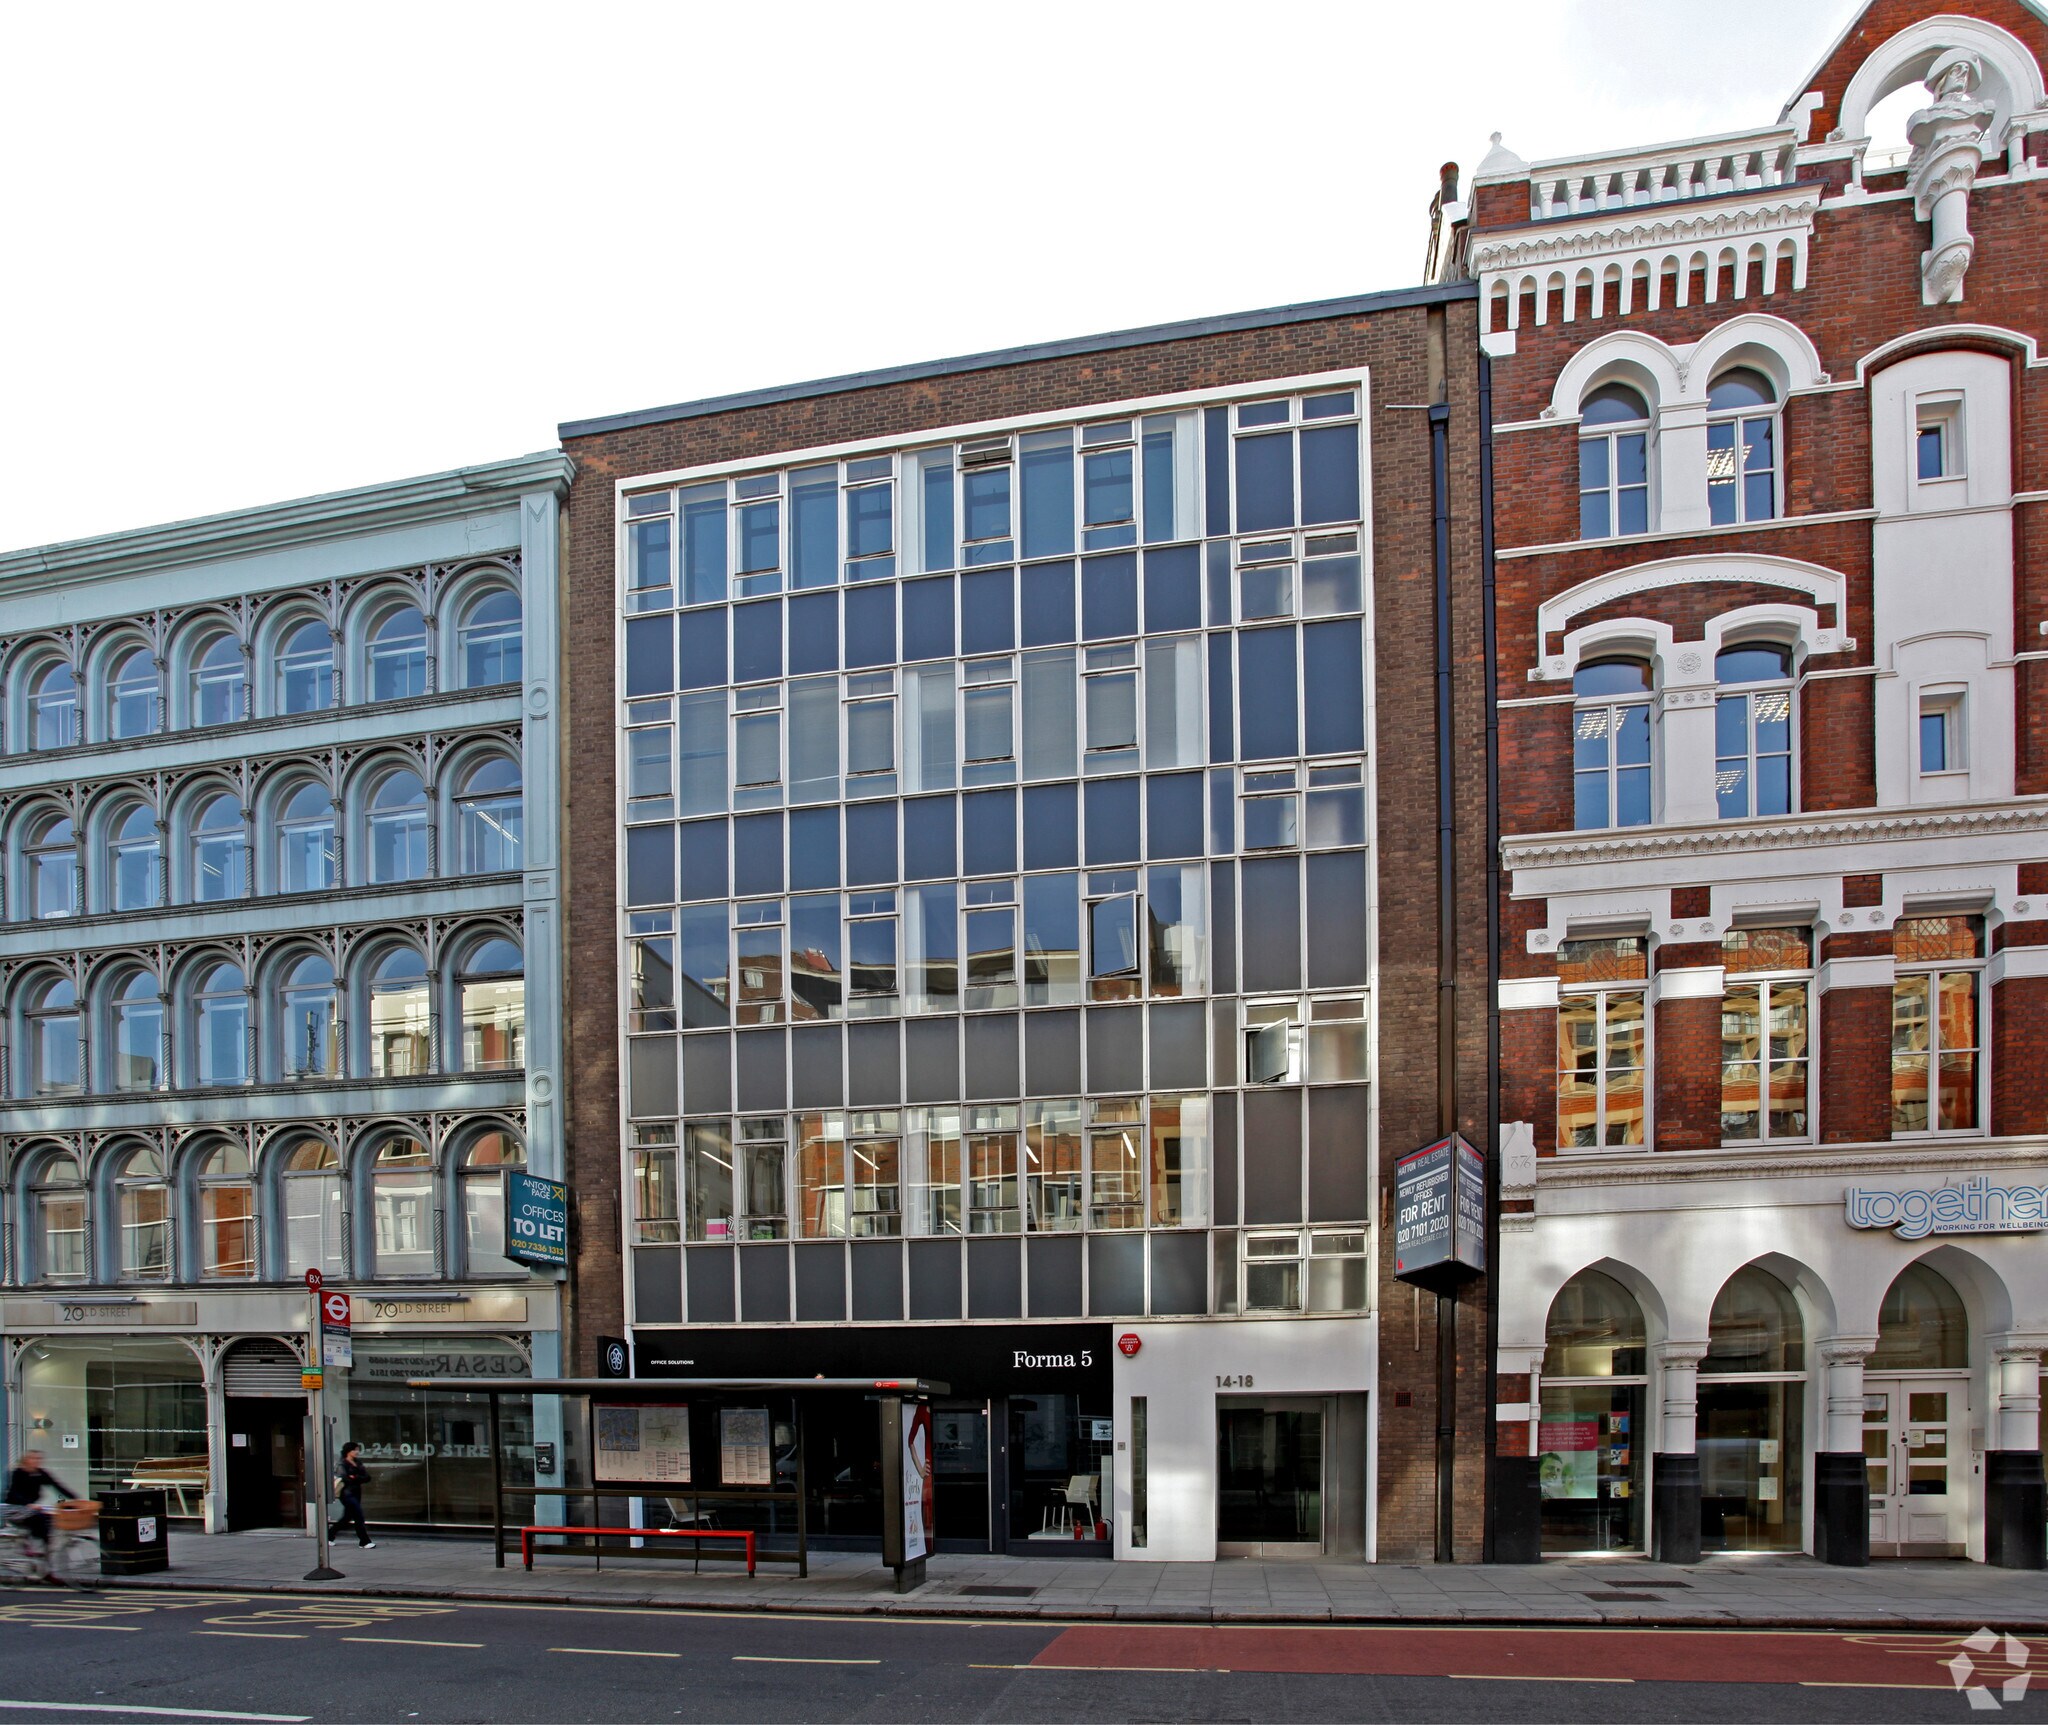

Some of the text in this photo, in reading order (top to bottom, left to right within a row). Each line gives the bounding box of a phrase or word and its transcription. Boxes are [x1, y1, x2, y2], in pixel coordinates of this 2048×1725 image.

[1397, 1161, 1416, 1177] HATTON
[1417, 1155, 1431, 1169] REAL
[1431, 1146, 1450, 1162] ESTATE
[522, 1179, 551, 1192] ANTON
[1399, 1185, 1415, 1199] NEWLY
[1416, 1171, 1449, 1192] REFURBISHED
[531, 1189, 551, 1200] PAGE
[1413, 1188, 1433, 1202] OFFICES
[522, 1204, 564, 1223] OFFICES
[1400, 1204, 1418, 1226] FOR
[1420, 1193, 1447, 1218] RENT
[513, 1217, 564, 1242] TO LET
[1397, 1214, 1449, 1244] 020 7101 2020
[1935, 1224, 1976, 1232] WORKING
[1999, 1221, 2048, 1230] WELLBEING
[511, 1239, 564, 1256] 020 7336 1313
[519, 1249, 565, 1262] antonpage.com
[309, 1274, 321, 1284] BX
[63, 1306, 85, 1322] 20
[100, 1307, 132, 1318] STREET
[374, 1302, 398, 1318] 20
[416, 1302, 453, 1313] STREET
[1012, 1350, 1093, 1368] Forma 5
[1215, 1374, 1254, 1388] 14-18
[356, 1442, 514, 1458] 0-24 OLD STRET
